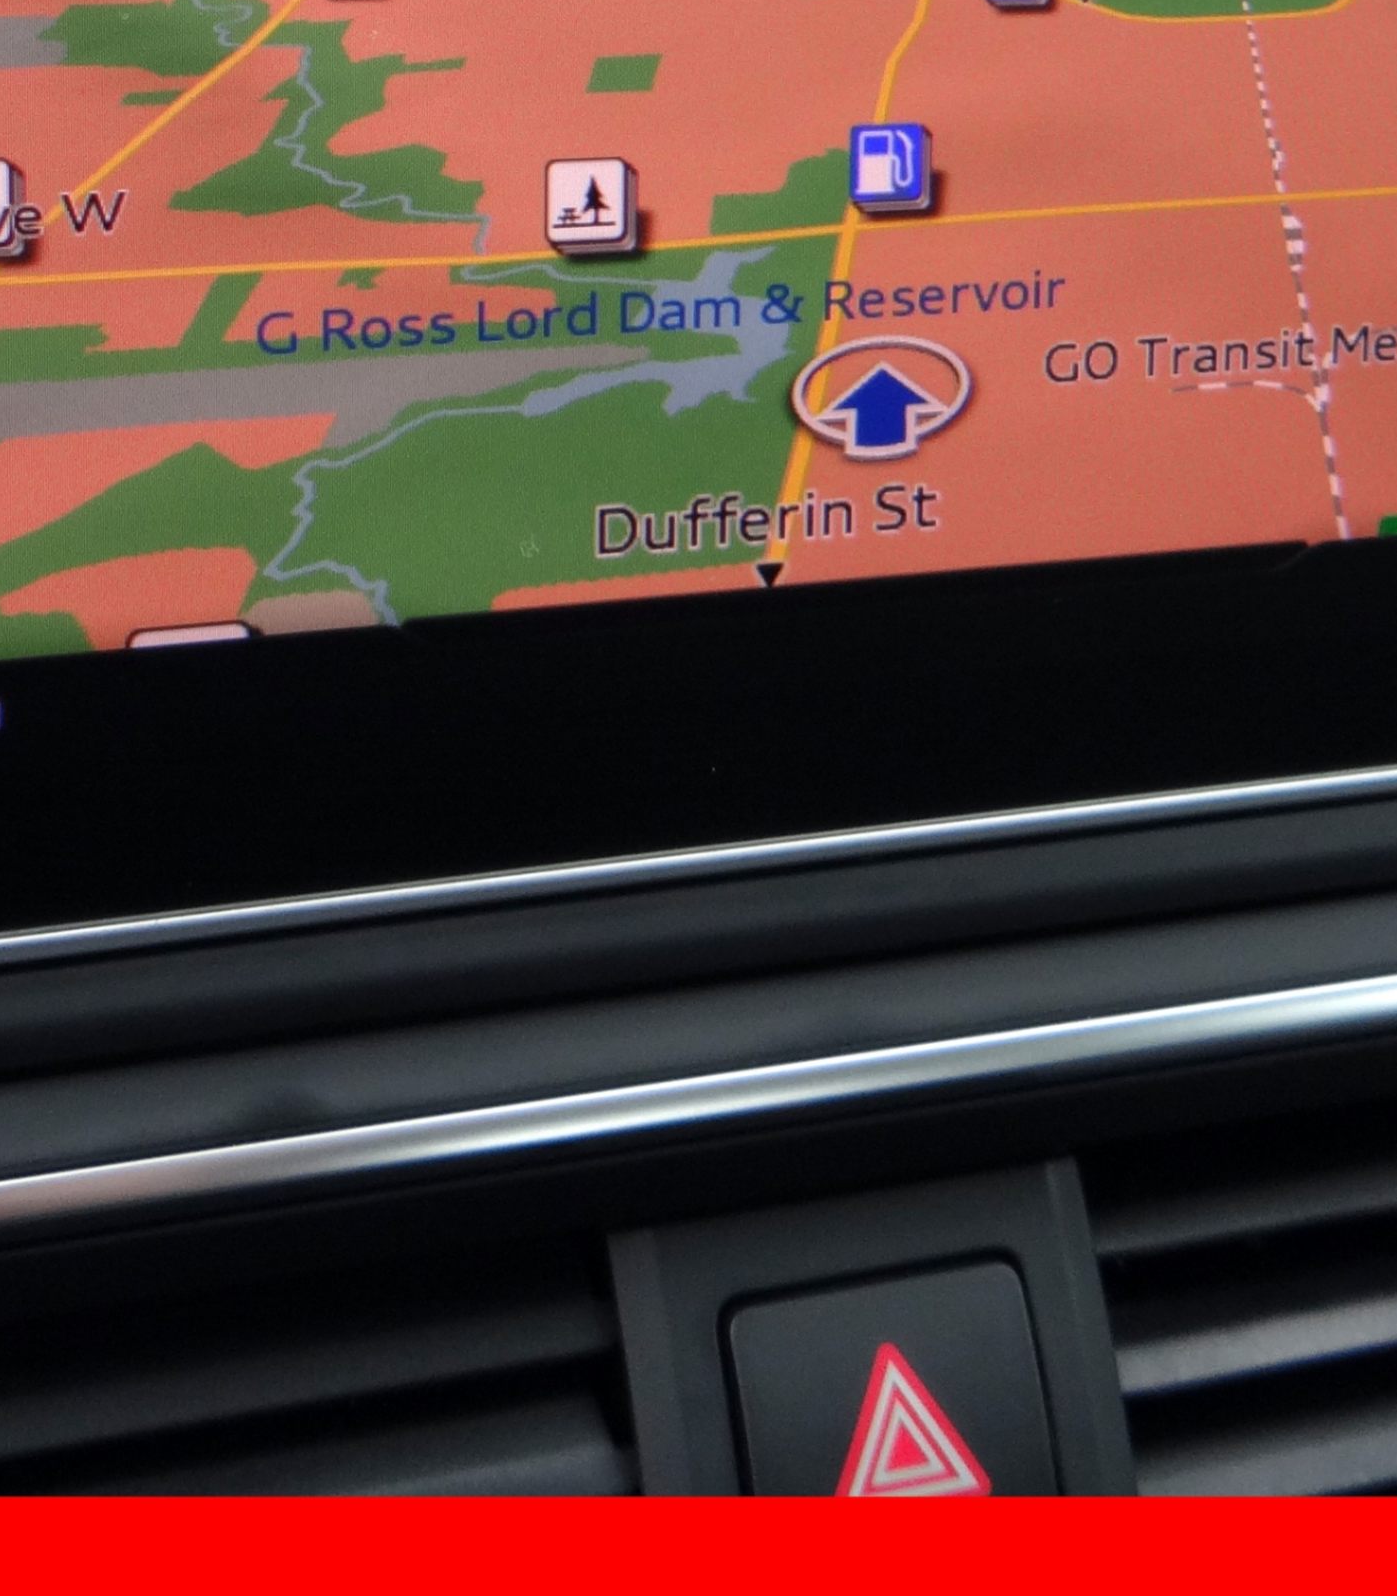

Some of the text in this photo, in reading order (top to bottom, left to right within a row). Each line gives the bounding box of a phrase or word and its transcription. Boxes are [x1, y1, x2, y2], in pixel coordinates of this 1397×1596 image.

[60, 191, 127, 233] W
[256, 269, 1067, 356] G Ross Lord Dam & Reservoir
[1044, 340, 1119, 383] GO
[1137, 330, 1315, 378] Transit
[597, 485, 938, 556] Dufferin St
